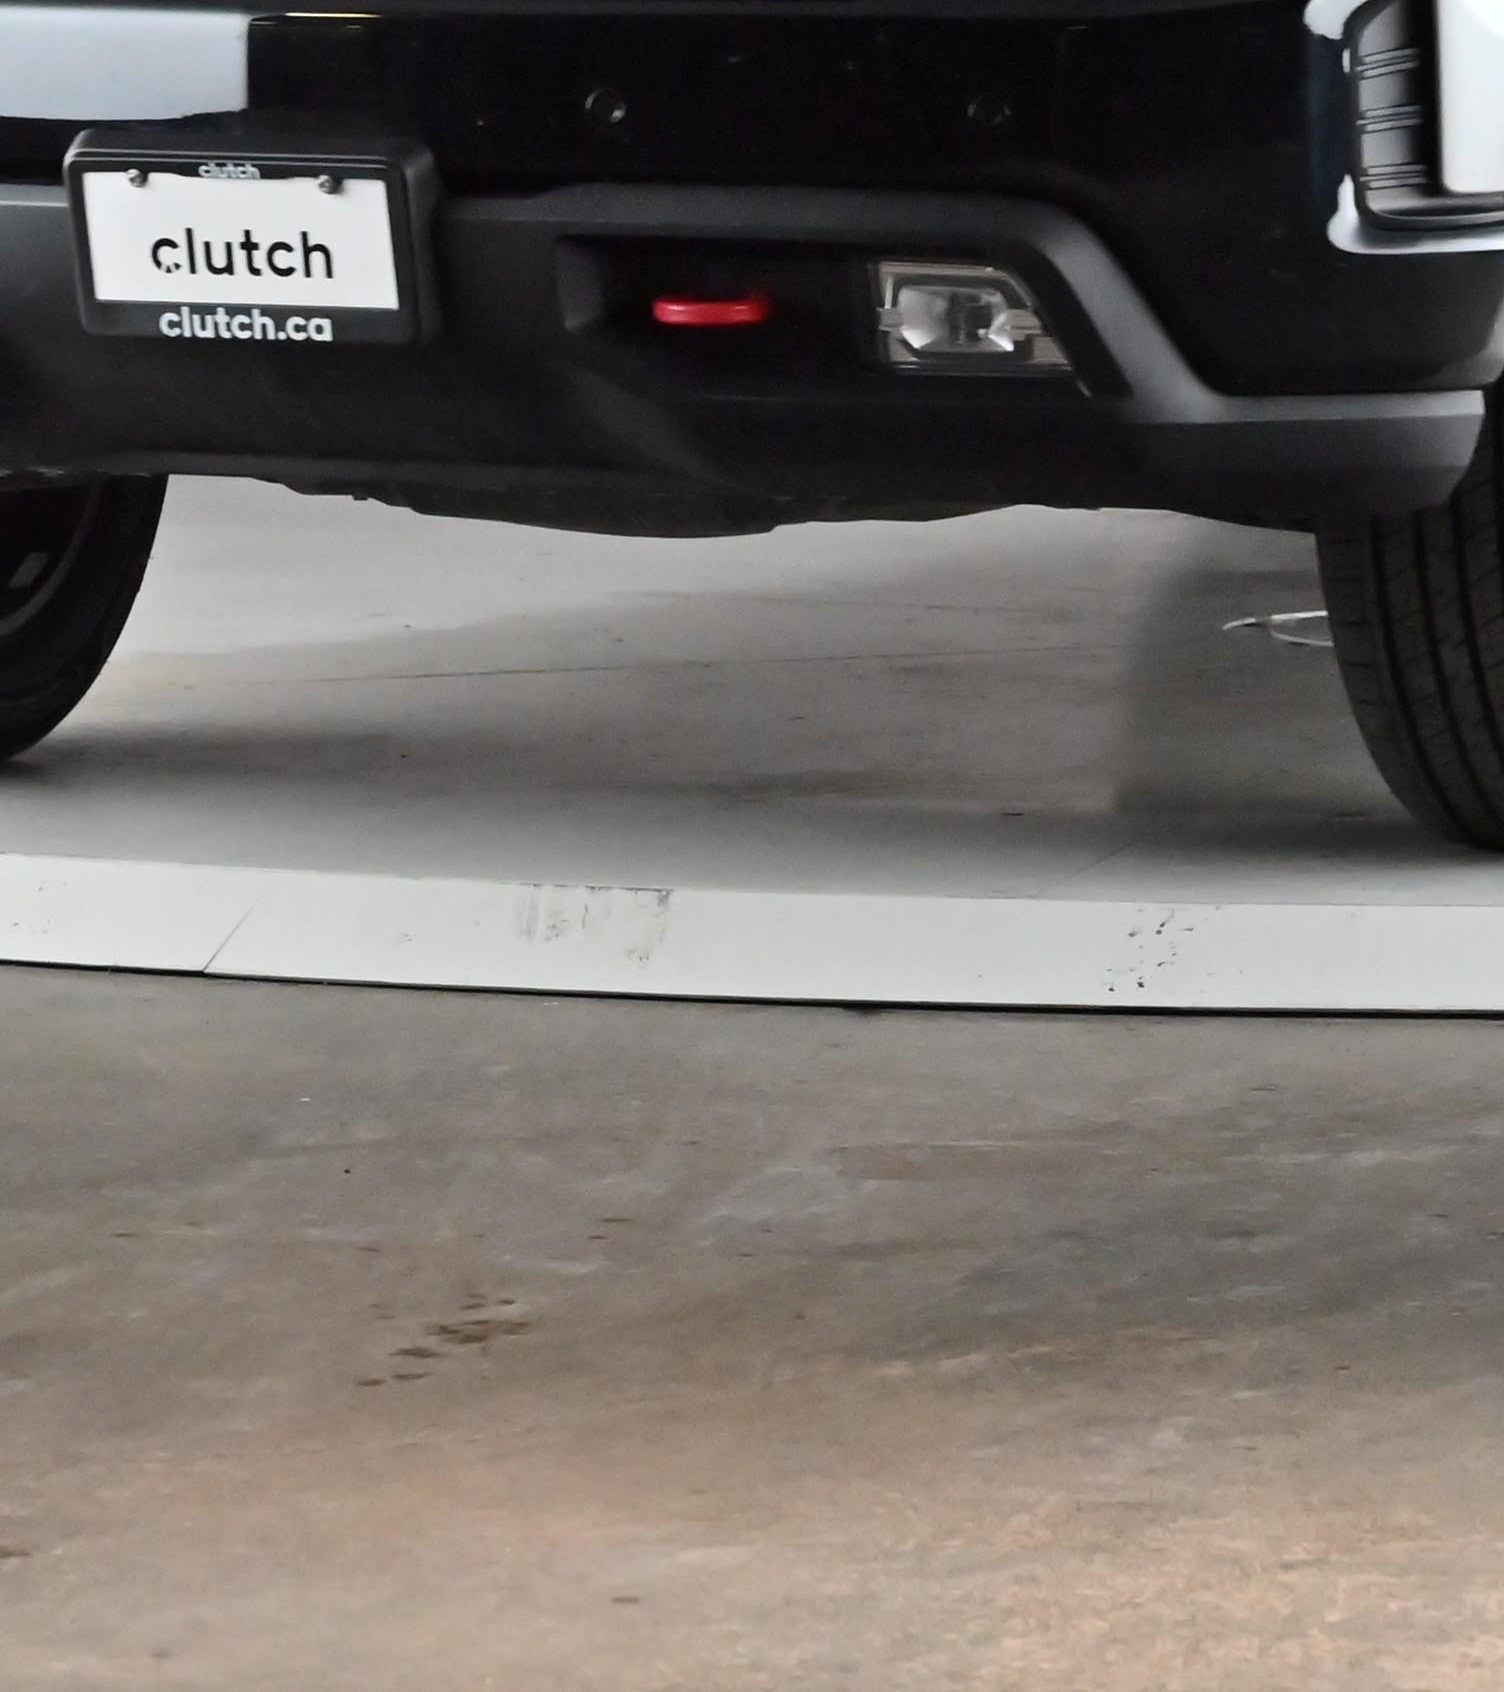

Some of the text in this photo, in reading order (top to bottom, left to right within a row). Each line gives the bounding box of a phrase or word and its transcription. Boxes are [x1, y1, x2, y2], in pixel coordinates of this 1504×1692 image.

[197, 160, 262, 180] clutch
[151, 227, 334, 279] clutch
[158, 306, 334, 342] clutch.ca
